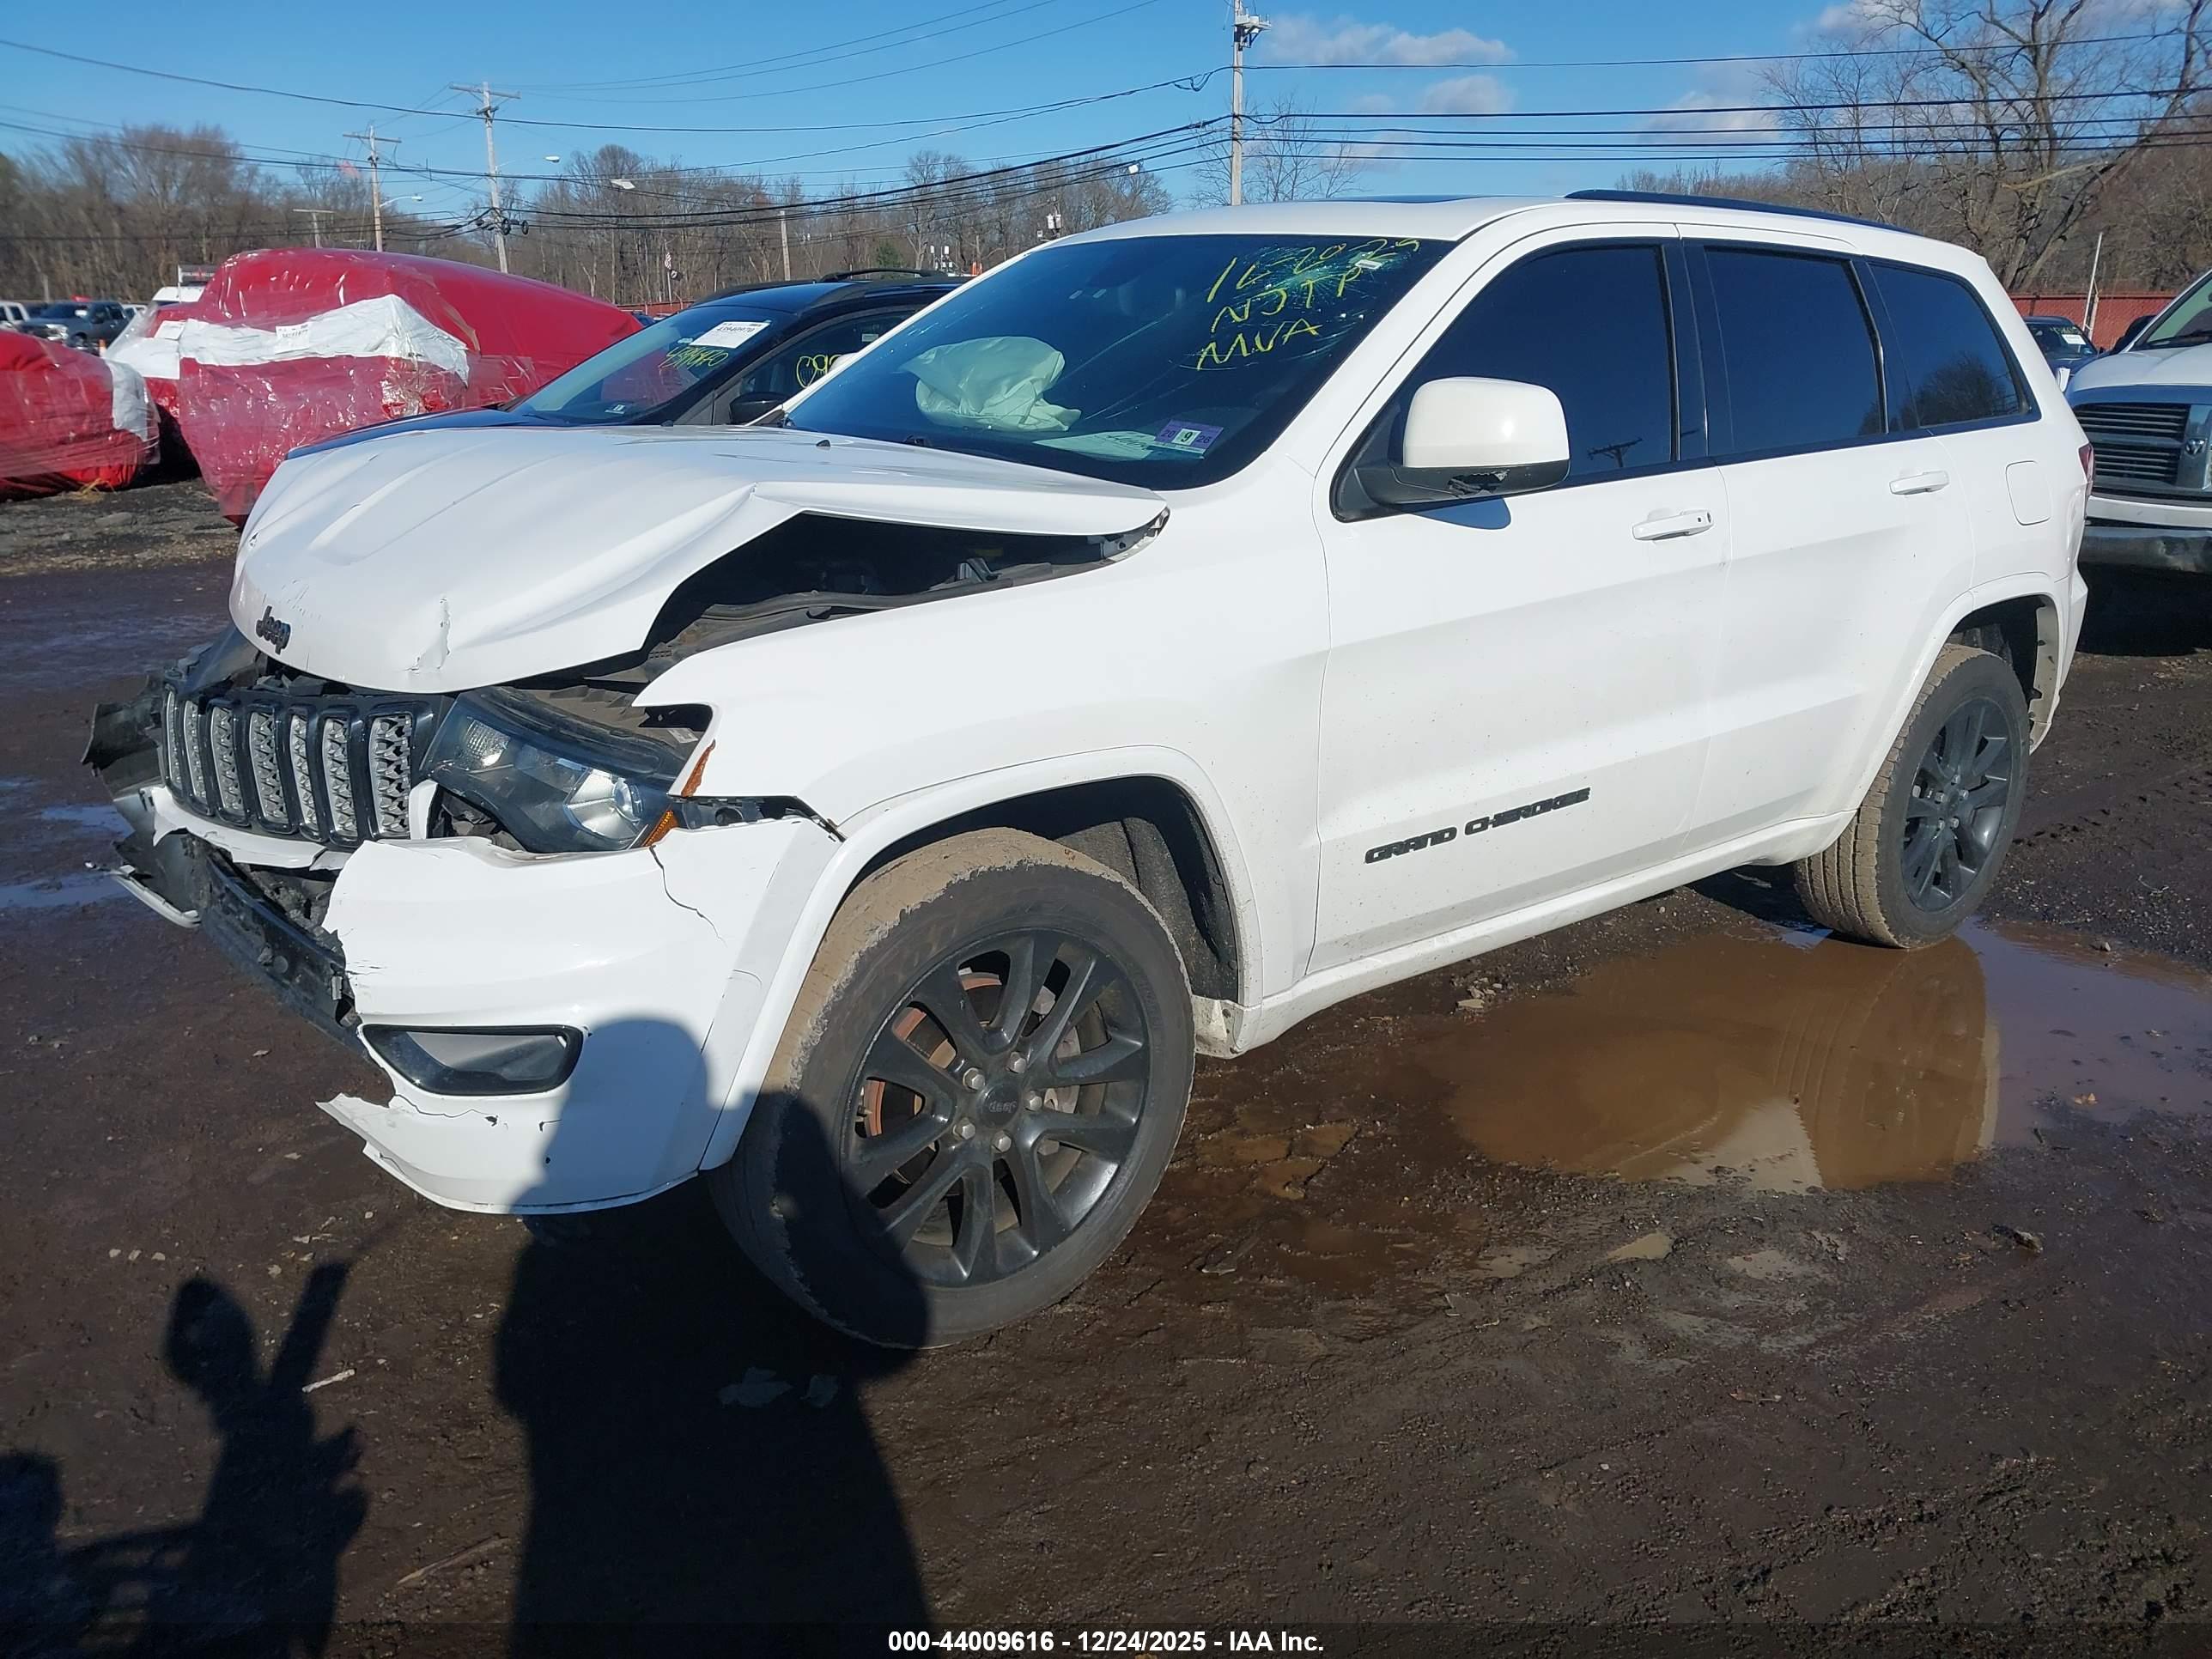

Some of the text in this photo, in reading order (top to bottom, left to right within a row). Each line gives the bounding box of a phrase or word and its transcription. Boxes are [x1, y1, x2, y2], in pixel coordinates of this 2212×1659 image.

[1196, 318, 1324, 372] MVA
[1181, 431, 1194, 443] 9
[255, 605, 291, 655] Jeep
[1364, 787, 1591, 864] GRAND CHEROKEE
